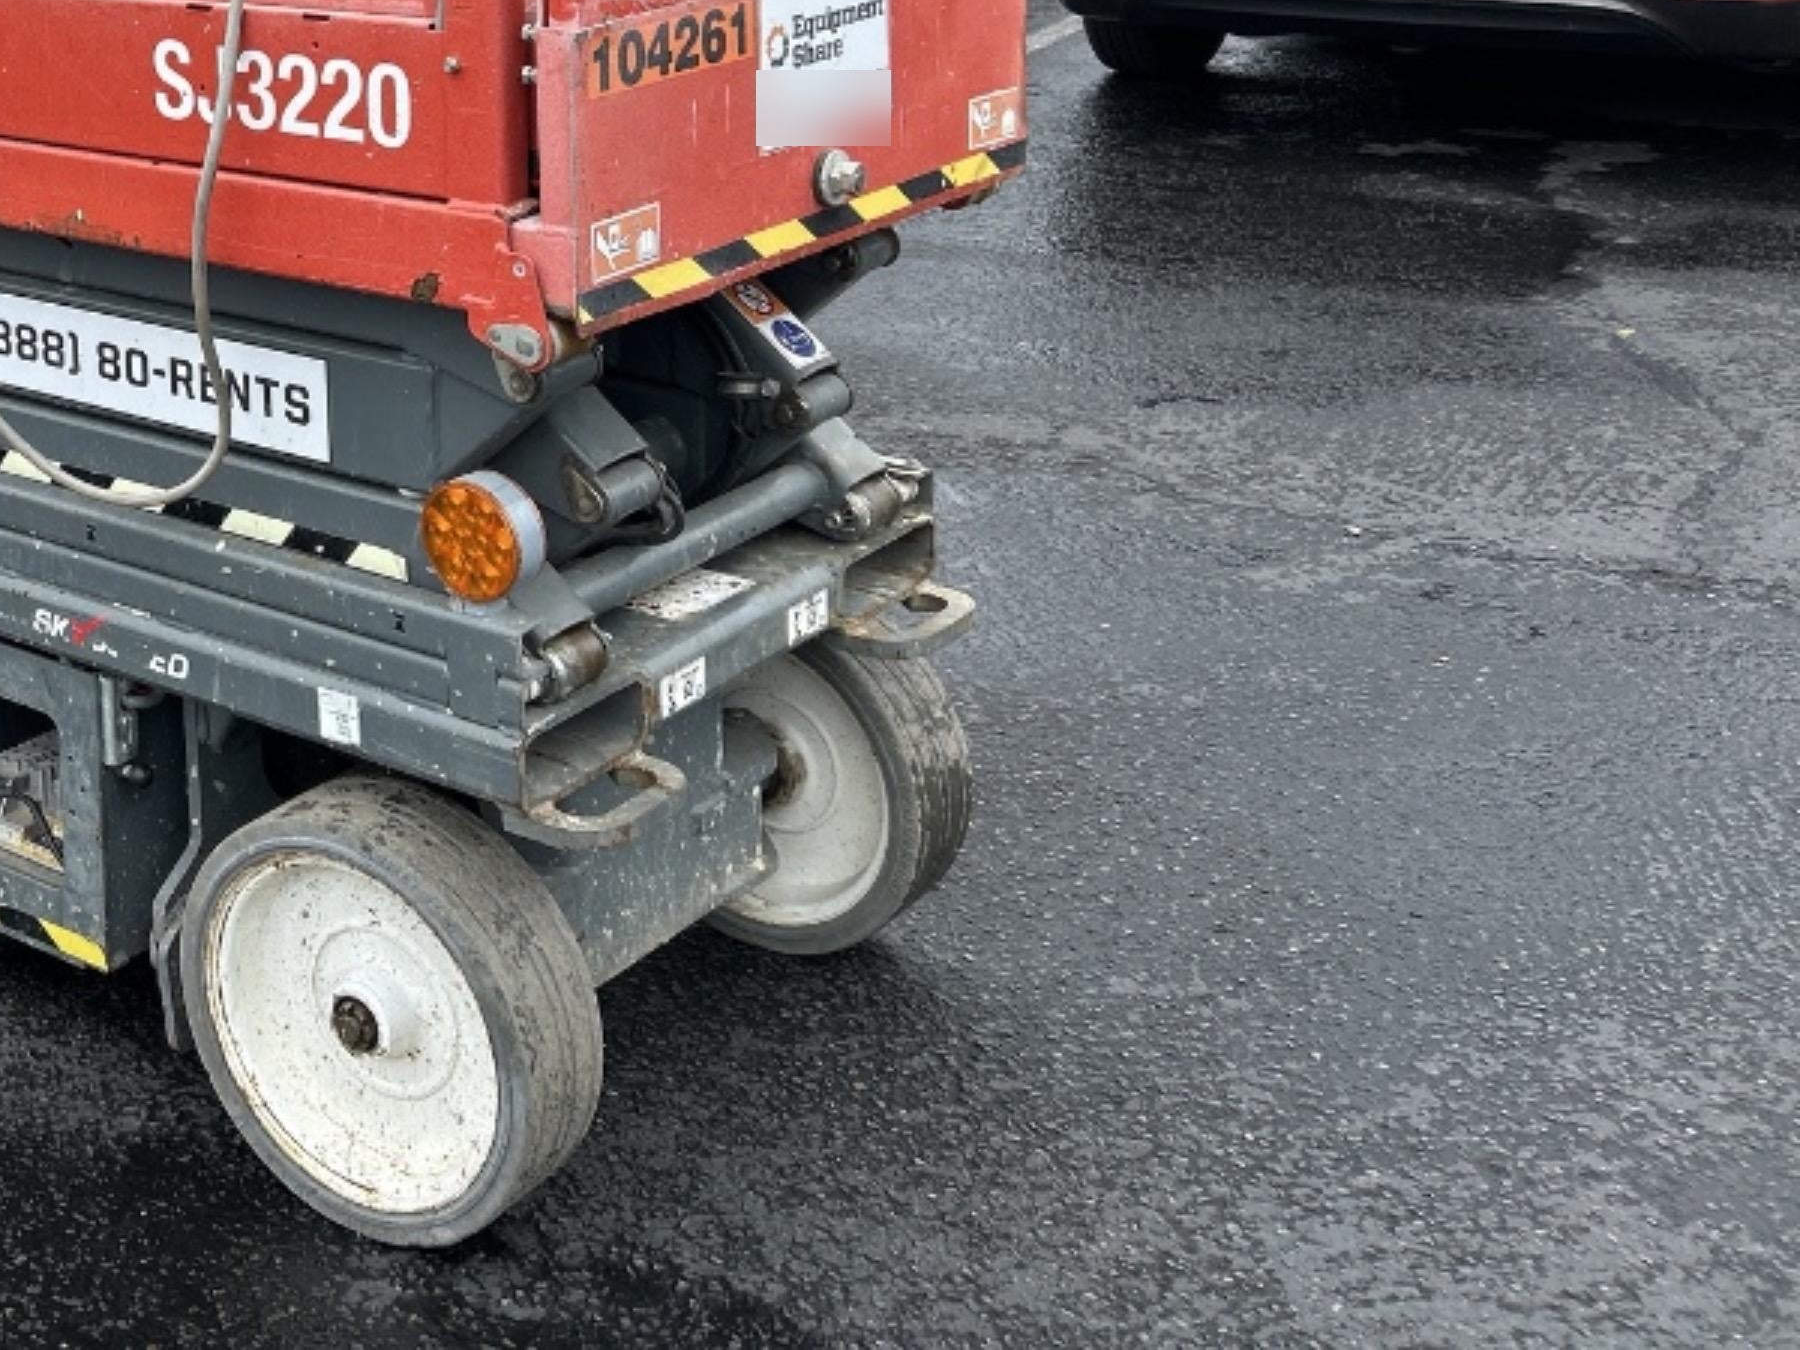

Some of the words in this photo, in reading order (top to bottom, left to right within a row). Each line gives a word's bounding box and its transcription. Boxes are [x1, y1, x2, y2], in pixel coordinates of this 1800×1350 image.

[593, 3, 748, 92] 104261
[792, 37, 844, 69] Share
[98, 340, 312, 426] 80-RENTS
